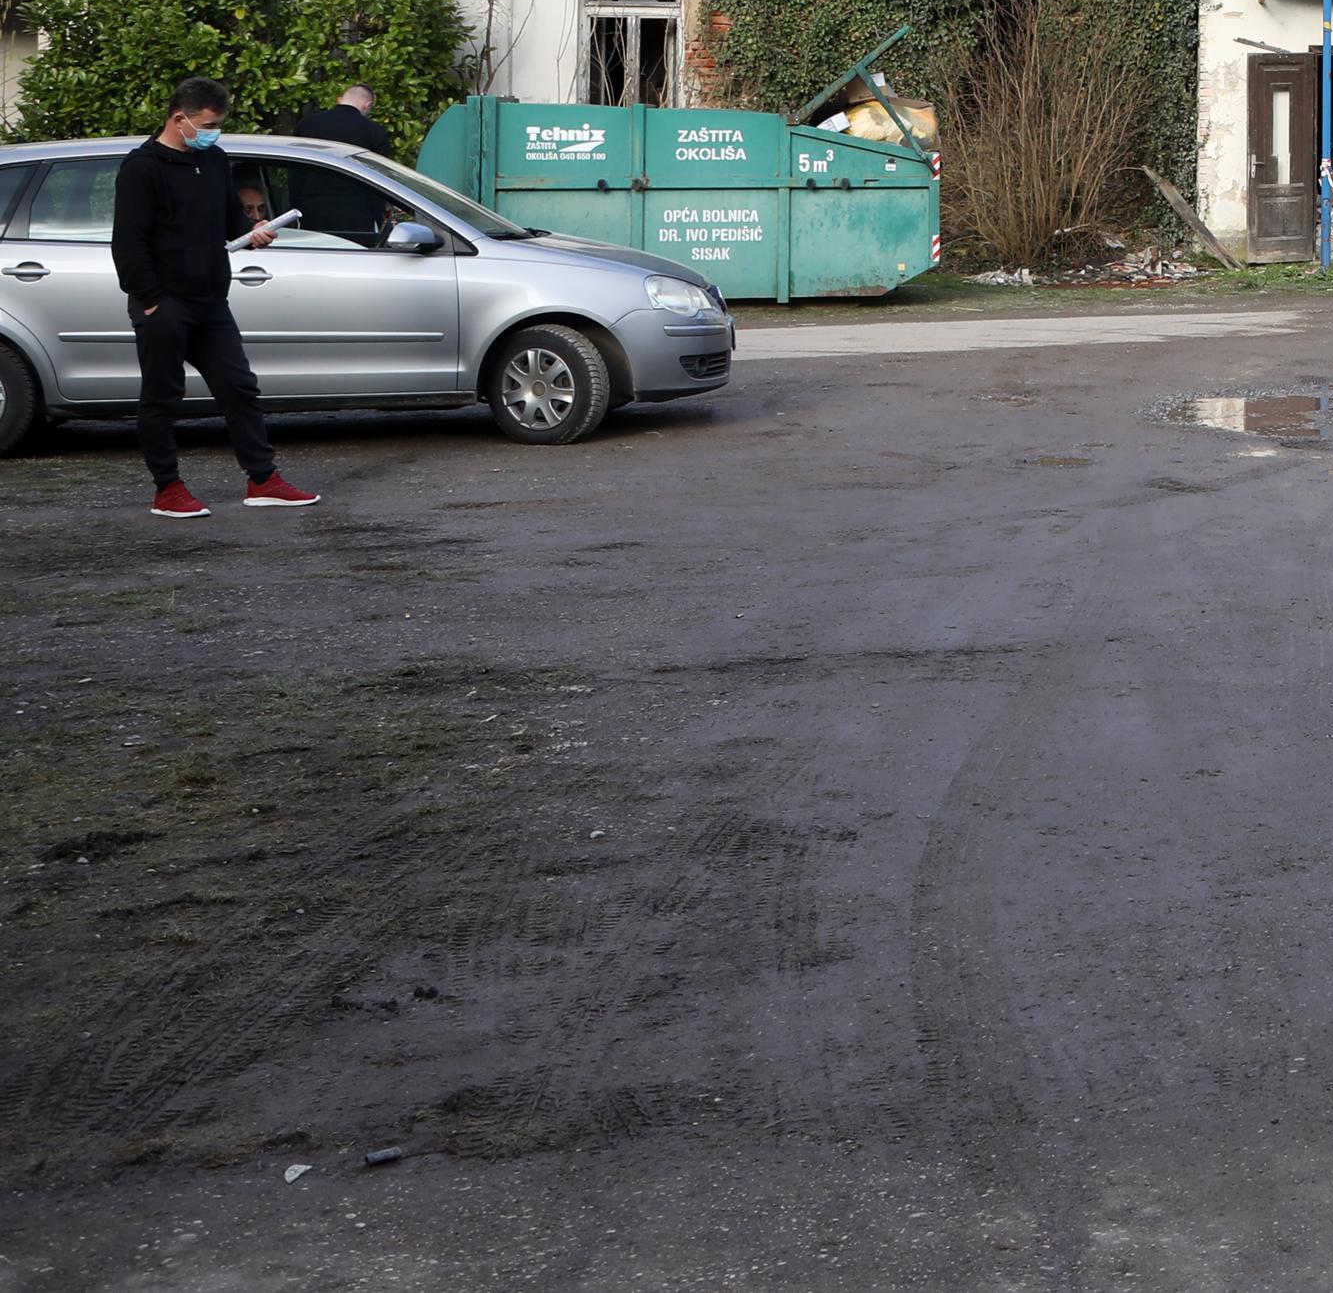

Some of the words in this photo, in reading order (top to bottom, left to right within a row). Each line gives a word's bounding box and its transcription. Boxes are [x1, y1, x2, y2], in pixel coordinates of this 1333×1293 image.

[526, 123, 606, 141] Tehnix
[677, 127, 744, 142] ZAŠTITA
[526, 141, 557, 150] ZAŠTITA
[675, 145, 747, 160] OKOLIŠA
[526, 151, 558, 160] OKOLIŠA
[560, 152, 575, 160] 040
[592, 152, 606, 160] 100
[798, 153, 810, 172] 5
[663, 207, 699, 223] OPĆA
[702, 209, 759, 223] BOLNICA
[659, 228, 682, 242] DR.
[686, 228, 708, 242] IVO
[711, 225, 763, 242] PEDIŠIĆ
[691, 247, 730, 261] SISAK
